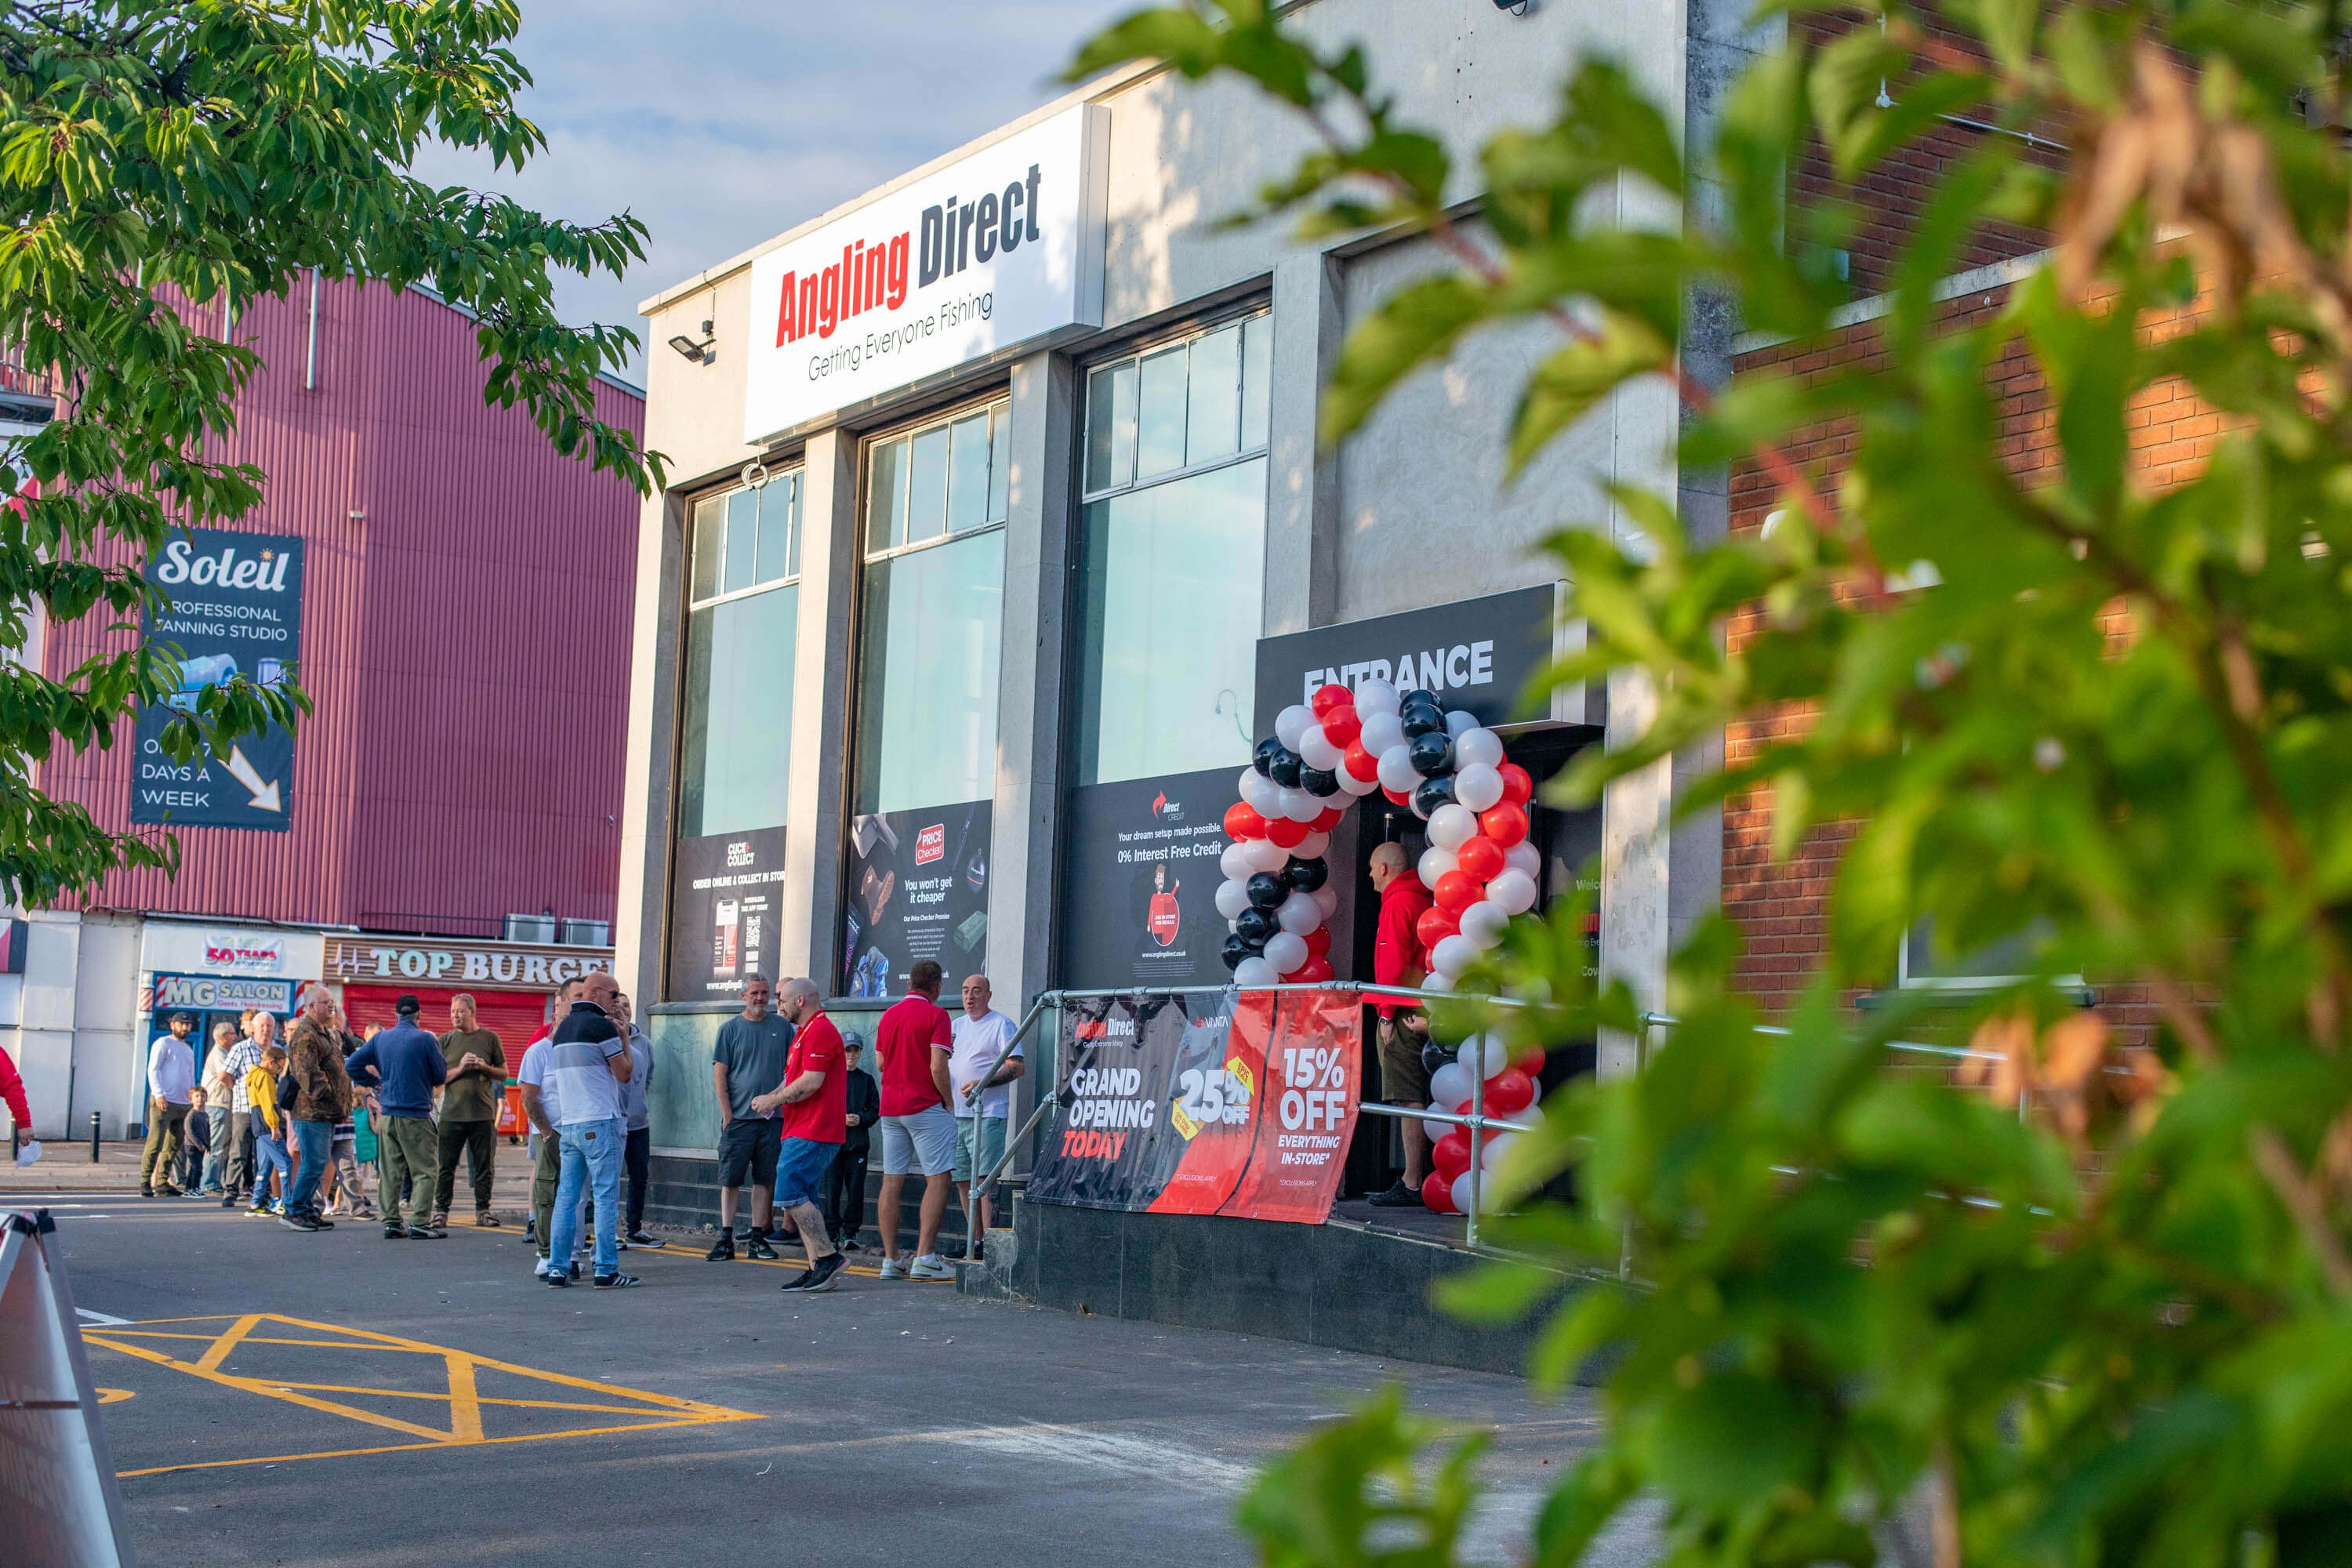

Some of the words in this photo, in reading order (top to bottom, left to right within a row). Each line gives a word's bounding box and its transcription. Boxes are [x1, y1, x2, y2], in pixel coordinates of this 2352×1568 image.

[775, 231, 909, 348] Angling
[919, 163, 1041, 289] Direct
[808, 345, 861, 381] Getting
[866, 315, 935, 359] Everyone
[941, 292, 993, 332] Fishing
[158, 541, 290, 592] Soleil
[230, 625, 287, 641] STUDIO
[142, 764, 191, 781] DAYS
[197, 768, 211, 782] A
[142, 789, 209, 807] WEEK
[1163, 802, 1180, 813] Direct
[1168, 812, 1185, 821] CREDIT
[922, 829, 942, 847] PRICE
[1118, 833, 1132, 842] Your
[1134, 831, 1153, 840] dream
[1154, 829, 1172, 840] setup
[1174, 826, 1192, 837] made
[1193, 822, 1221, 837] possible.
[728, 852, 754, 866] COLLECT
[1118, 850, 1132, 863] 0%
[1134, 847, 1168, 862] Interest
[1171, 845, 1190, 858] Free
[1193, 840, 1222, 856] Credit
[693, 878, 711, 889] ORDER
[712, 876, 732, 887] ONLINE
[738, 873, 761, 884] COLLECT
[763, 872, 769, 882] IN
[905, 880, 917, 891] You
[919, 877, 939, 890] won't
[940, 876, 953, 891] get
[909, 892, 916, 904] it
[916, 891, 945, 905] cheaper
[207, 947, 234, 965] 50
[370, 949, 453, 979] TOP
[163, 981, 216, 1007] MG
[219, 982, 284, 1000] SALON
[241, 1000, 283, 1011] Hairdressing
[1075, 1019, 1107, 1040] Angling
[1107, 1018, 1134, 1036] Direct
[1283, 1047, 1345, 1088] 15%
[1071, 1068, 1141, 1096] GRAND
[1180, 1069, 1250, 1123] 25%
[1069, 1099, 1155, 1128] OPENING
[1222, 1105, 1250, 1124] OFF
[1280, 1089, 1346, 1131] OFF
[1061, 1131, 1127, 1160] TODAY
[1278, 1135, 1341, 1149] EVERYTHING
